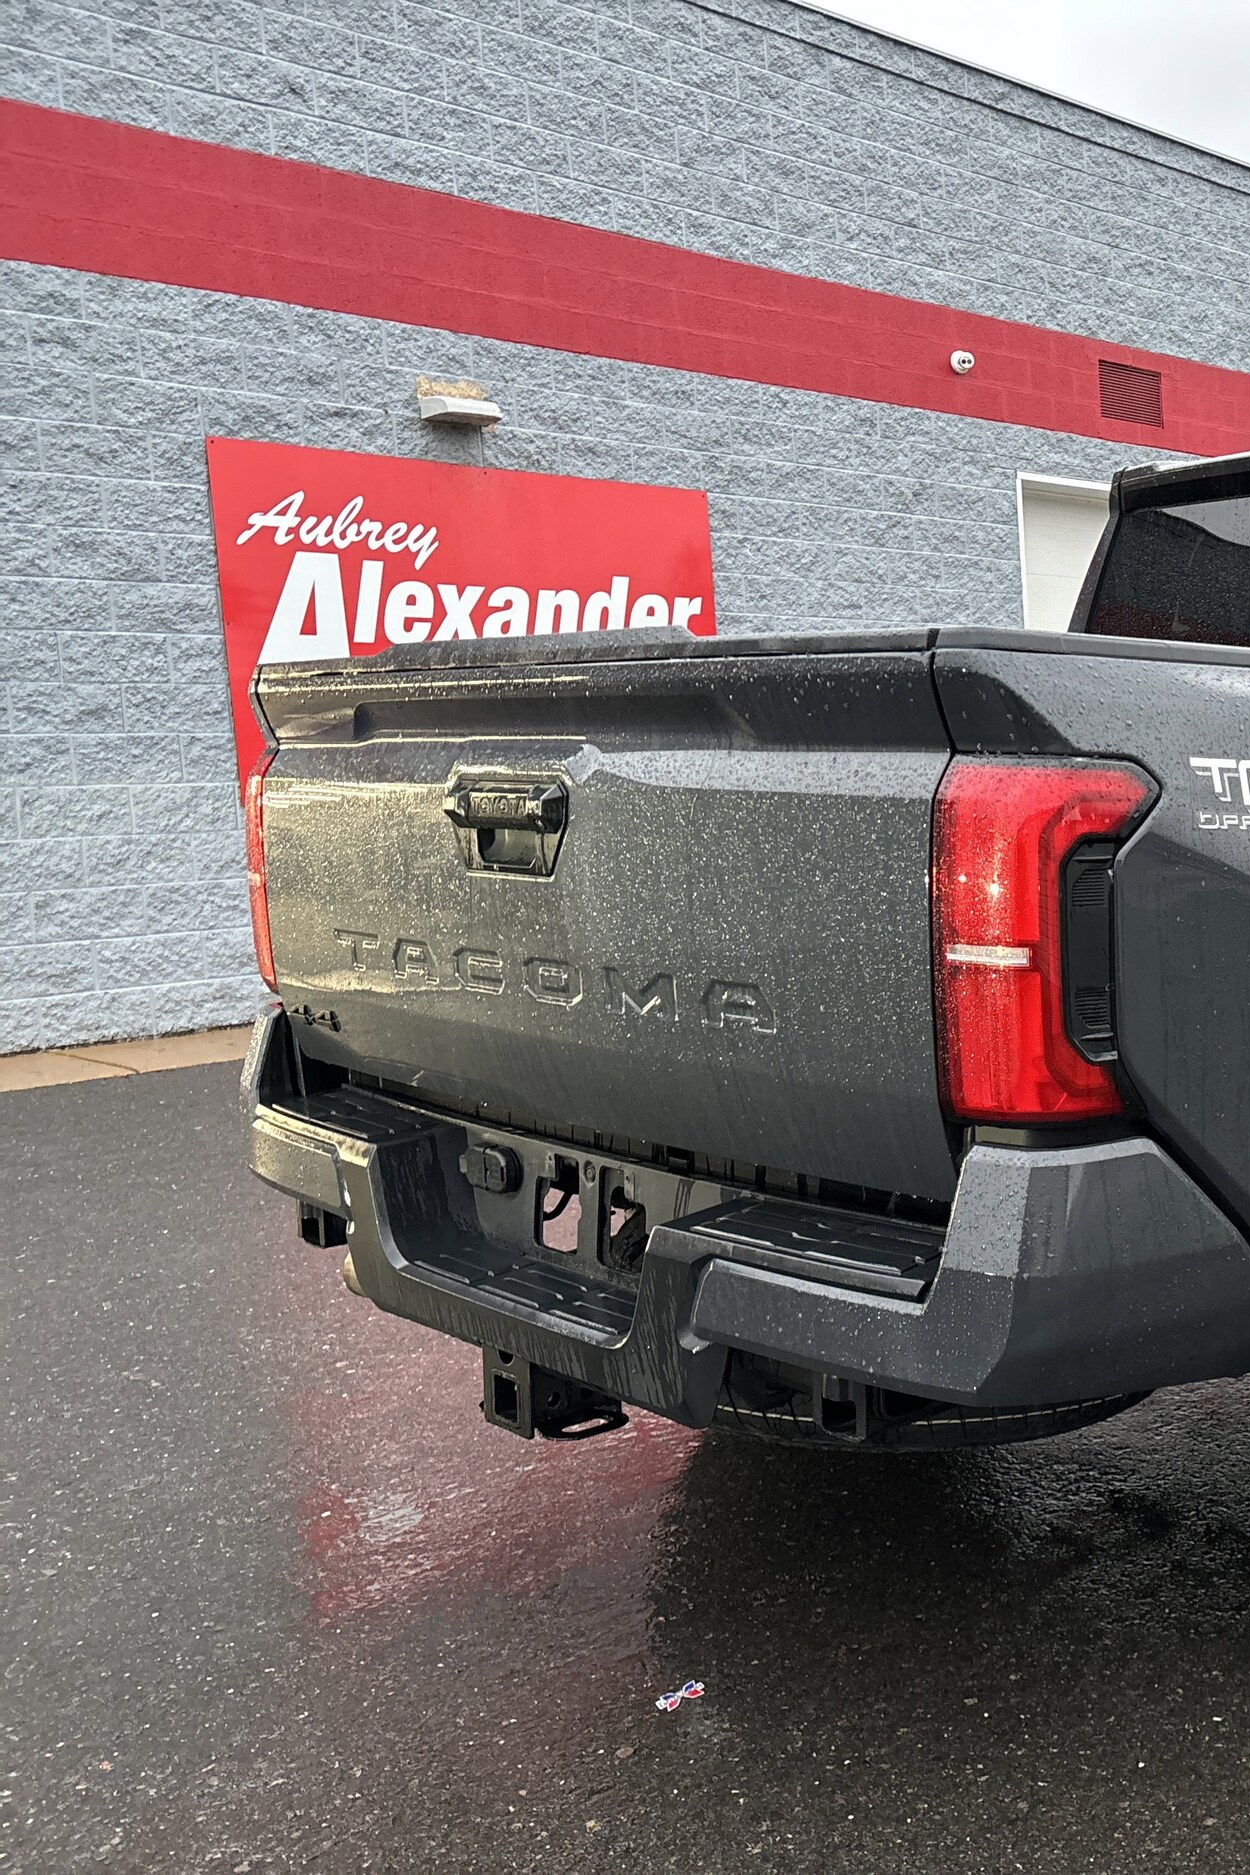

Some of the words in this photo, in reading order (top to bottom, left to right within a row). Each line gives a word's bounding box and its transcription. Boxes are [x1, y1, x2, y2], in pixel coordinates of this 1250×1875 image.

[237, 491, 439, 570] Aubrey
[258, 551, 702, 664] Alexander
[472, 795, 527, 815] TOYOTA
[334, 927, 776, 1034] TACOMA
